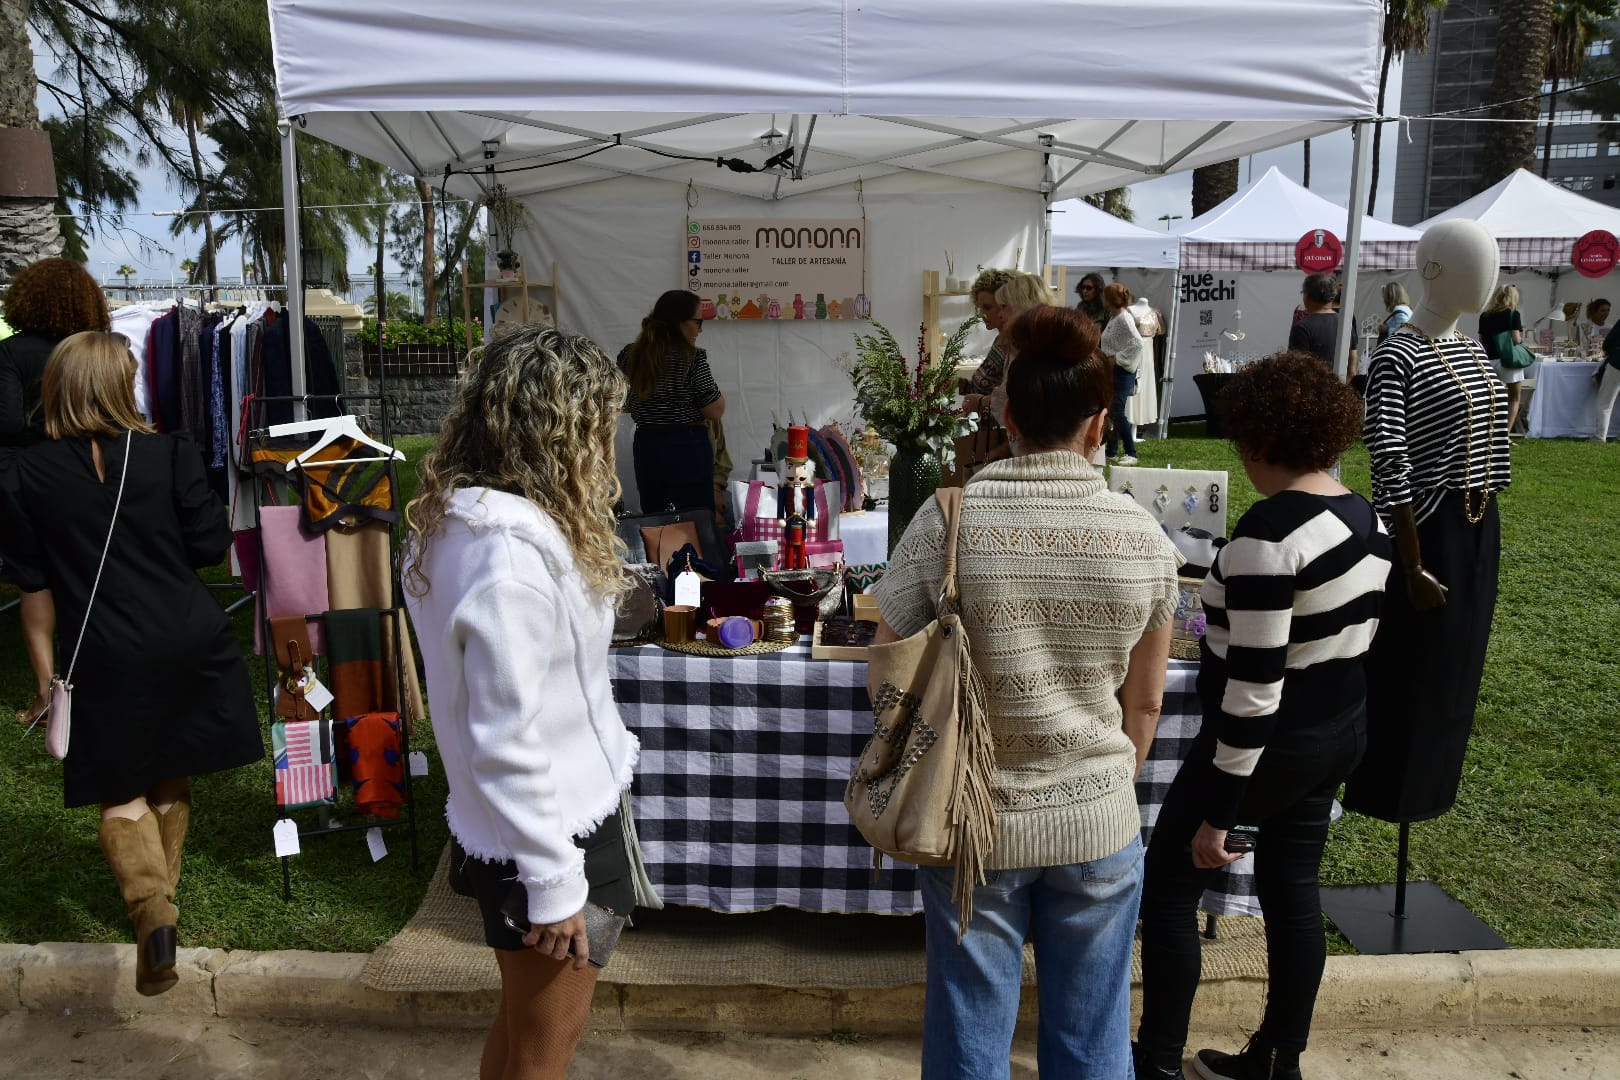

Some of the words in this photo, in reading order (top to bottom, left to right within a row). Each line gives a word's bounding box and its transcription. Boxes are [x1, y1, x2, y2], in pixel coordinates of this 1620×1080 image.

[772, 257, 796, 265] TALLER
[798, 257, 808, 265] DE
[810, 256, 847, 265] ARTESANÍA
